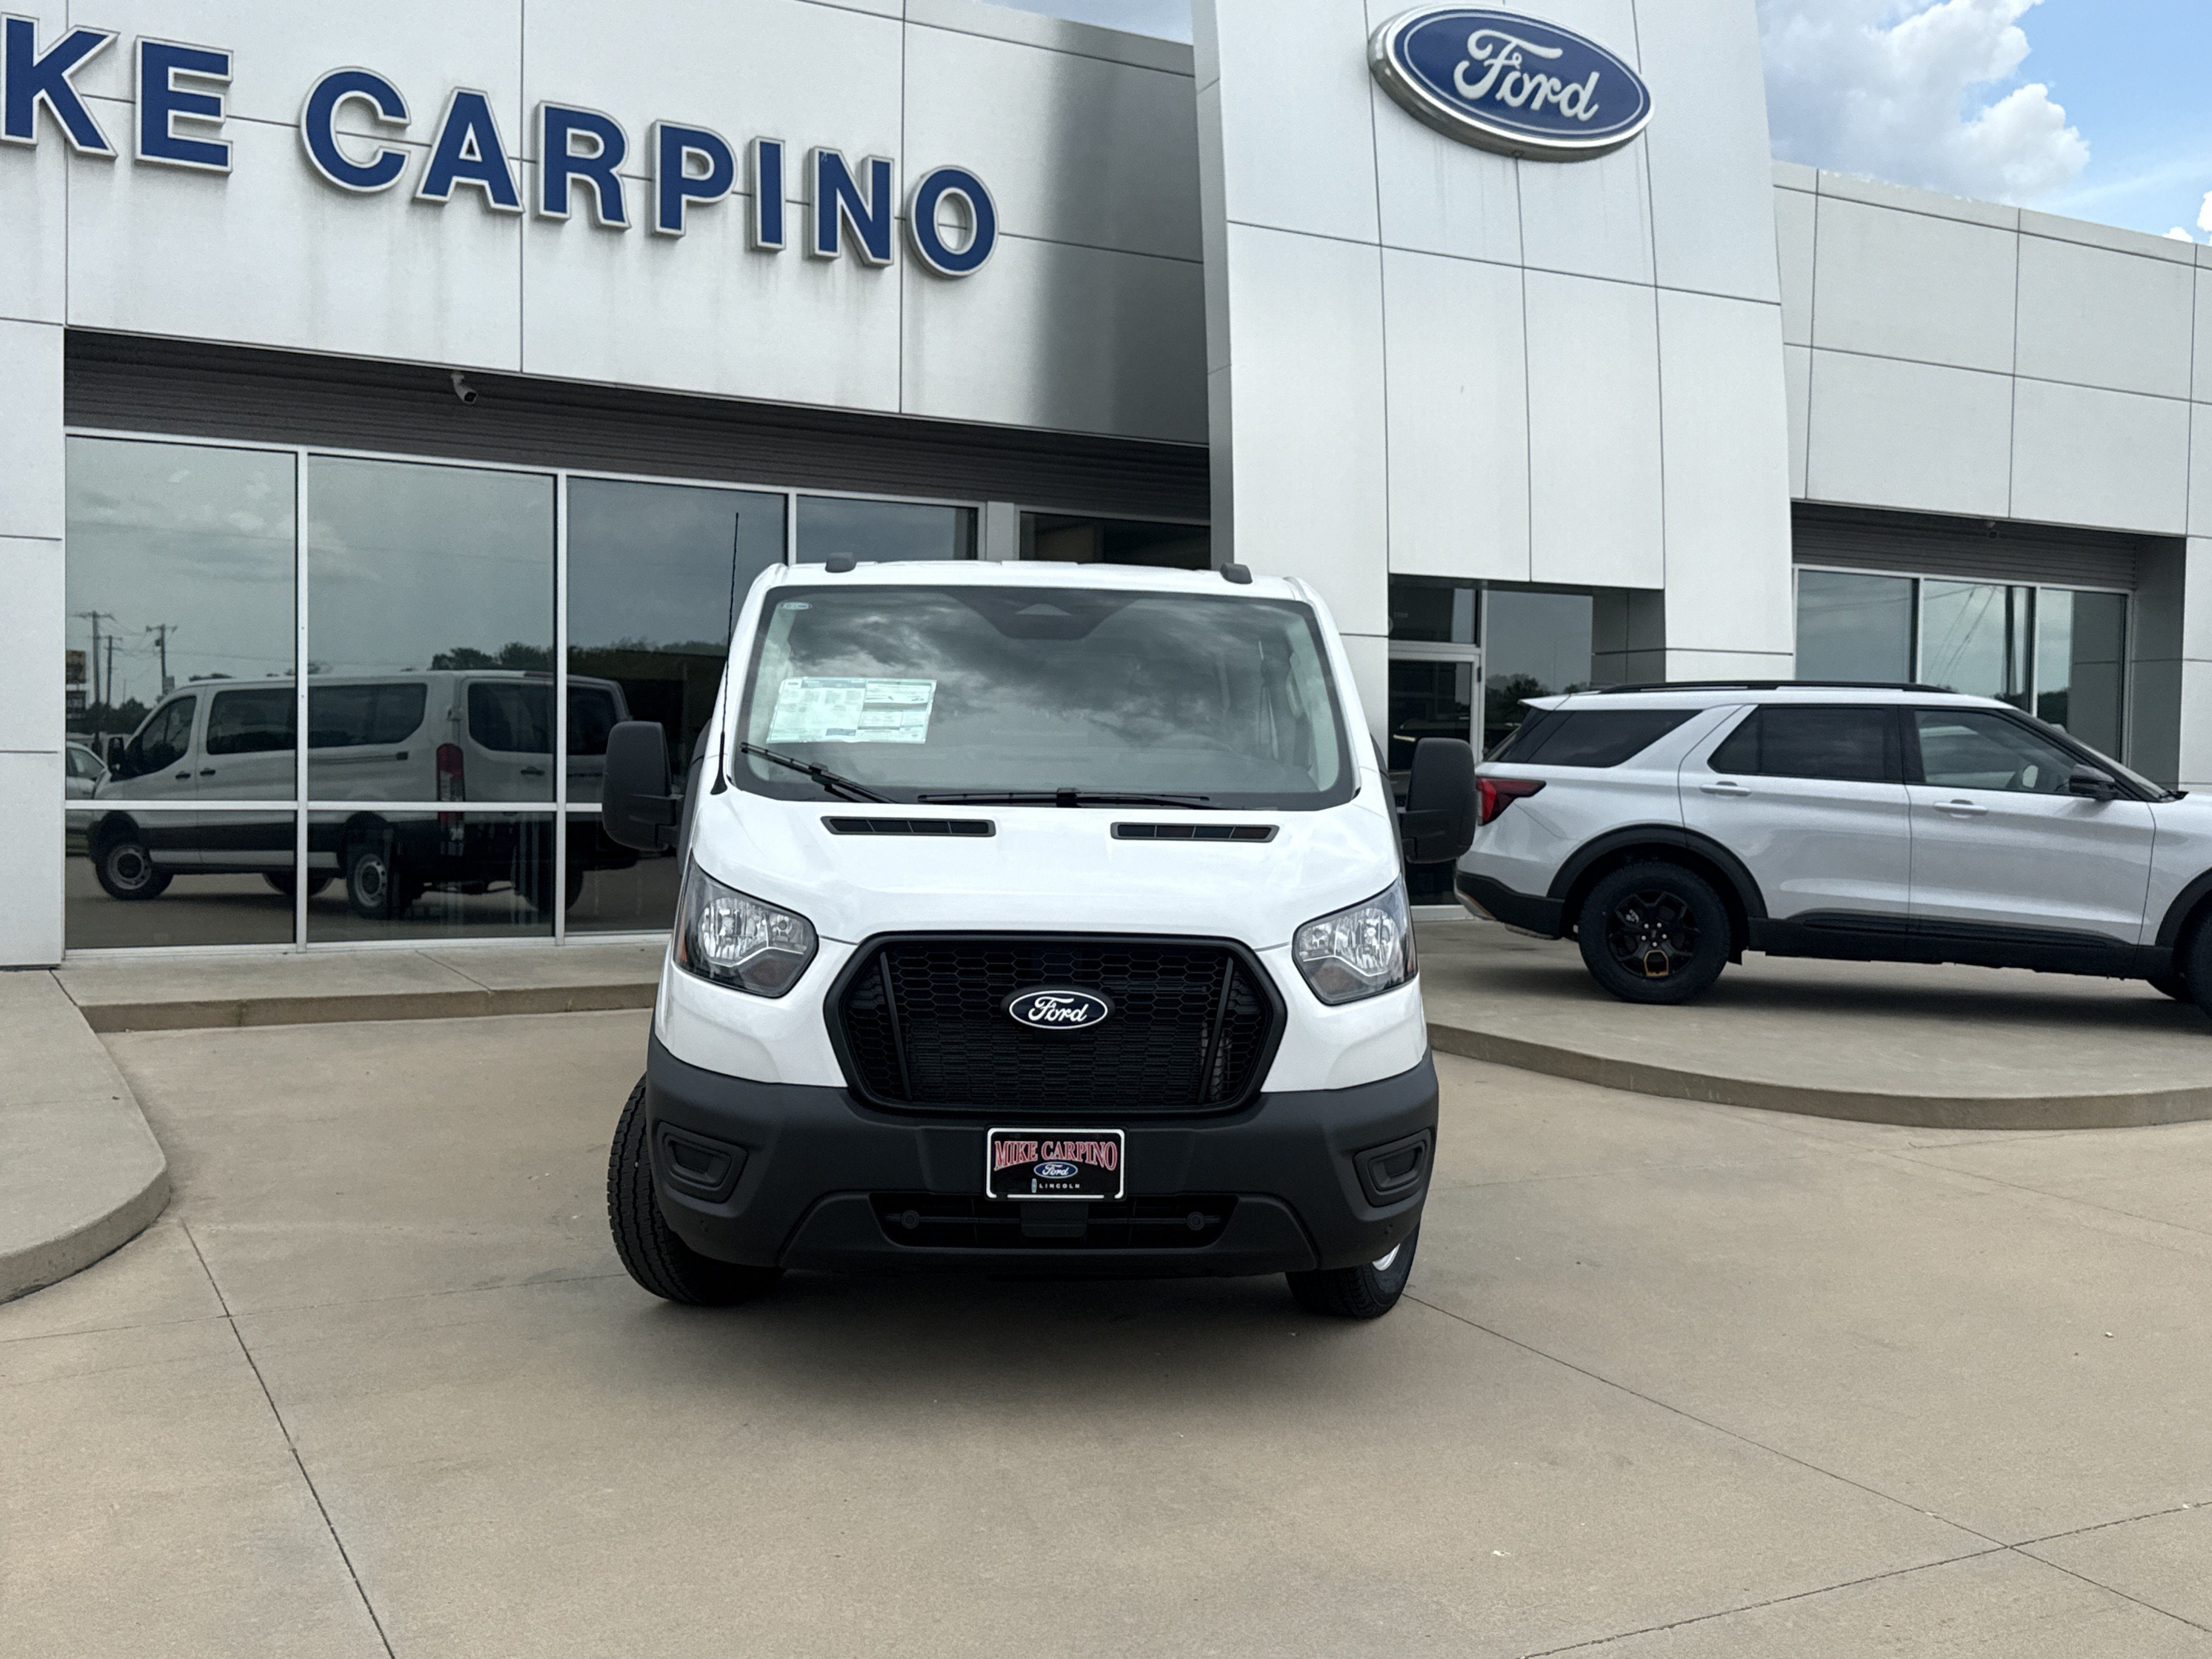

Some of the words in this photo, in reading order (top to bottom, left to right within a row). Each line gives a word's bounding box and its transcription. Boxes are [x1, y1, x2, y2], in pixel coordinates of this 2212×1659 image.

[1453, 29, 1600, 121] Ford
[299, 65, 998, 278] CARPINO
[1028, 996, 1090, 1022] Ford
[994, 1141, 1039, 1172] MIKE
[1041, 1141, 1118, 1171] CARPINO
[1042, 1163, 1070, 1176] Ford
